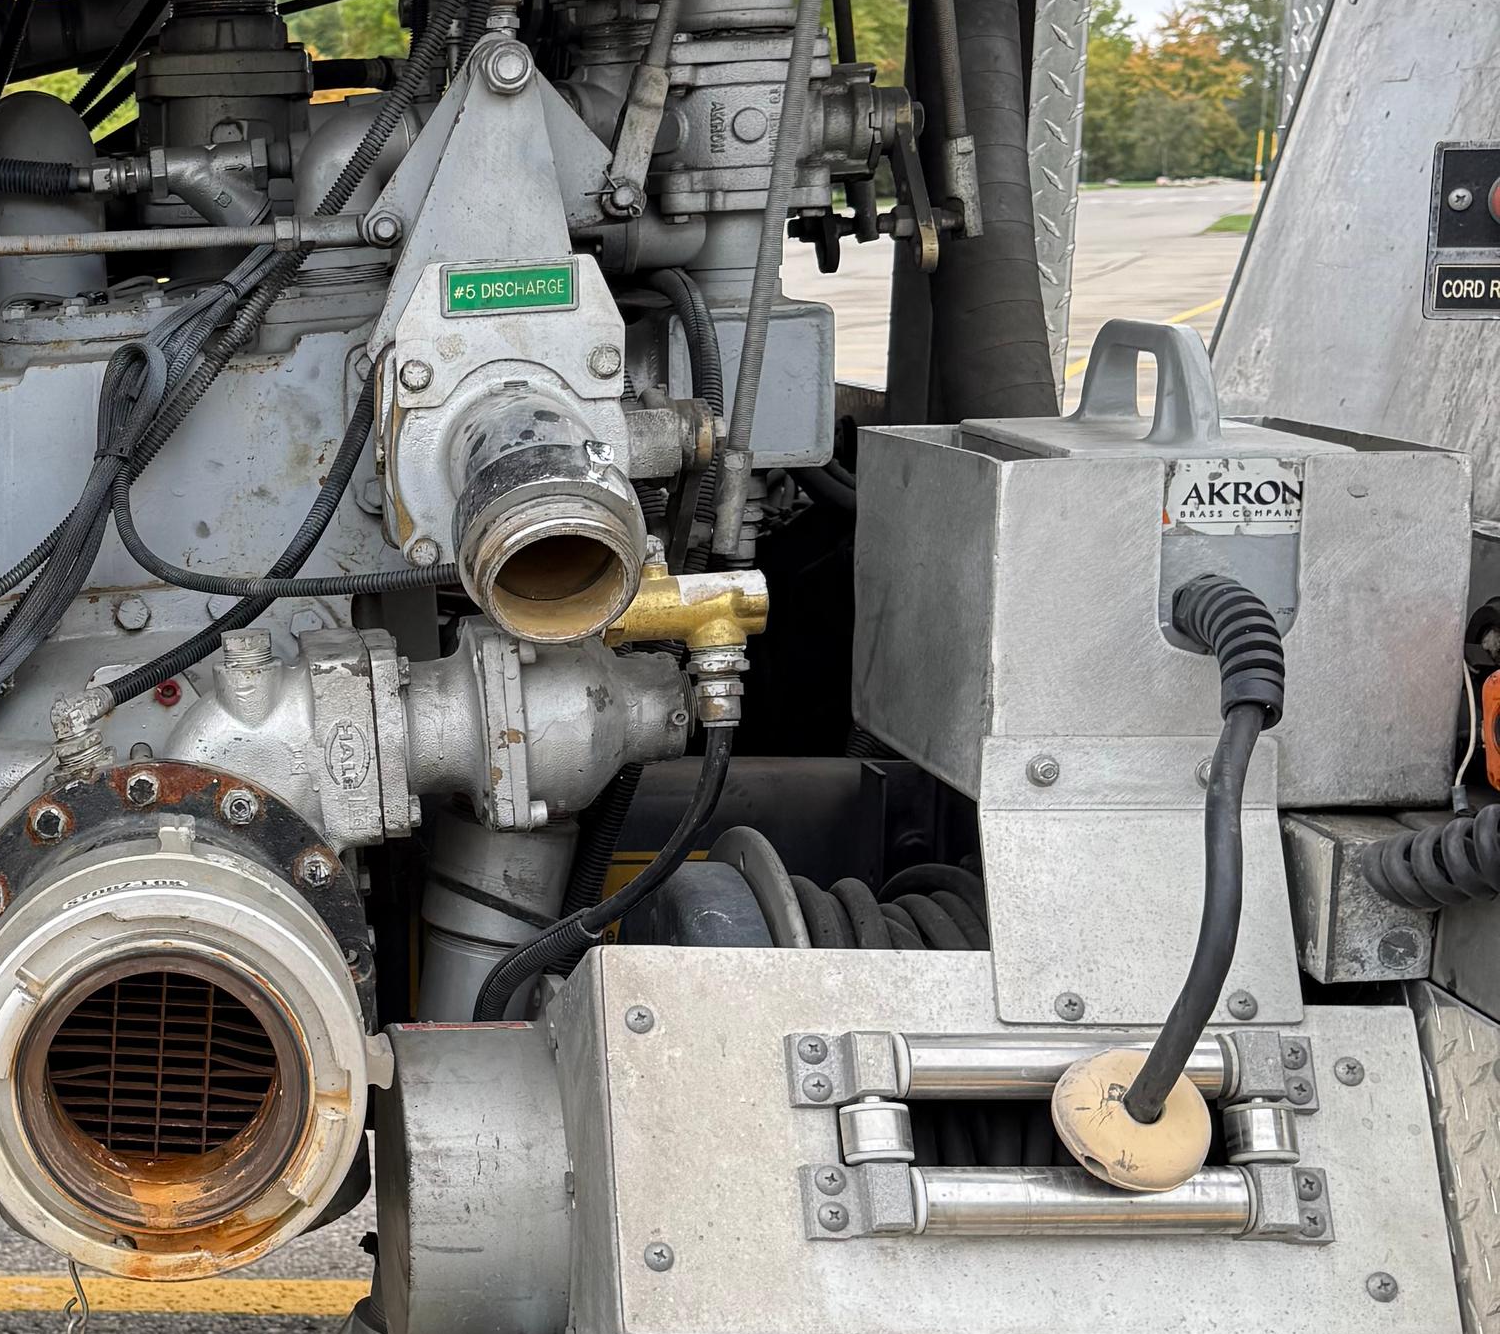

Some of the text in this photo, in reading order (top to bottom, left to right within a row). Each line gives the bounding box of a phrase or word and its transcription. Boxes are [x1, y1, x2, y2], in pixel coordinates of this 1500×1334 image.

[453, 278, 565, 300] #5 DISCHARGE
[1442, 280, 1485, 299] CORD
[1181, 480, 1303, 506] AKRON
[1180, 509, 1223, 519] BRASS
[338, 719, 356, 789] HALE
